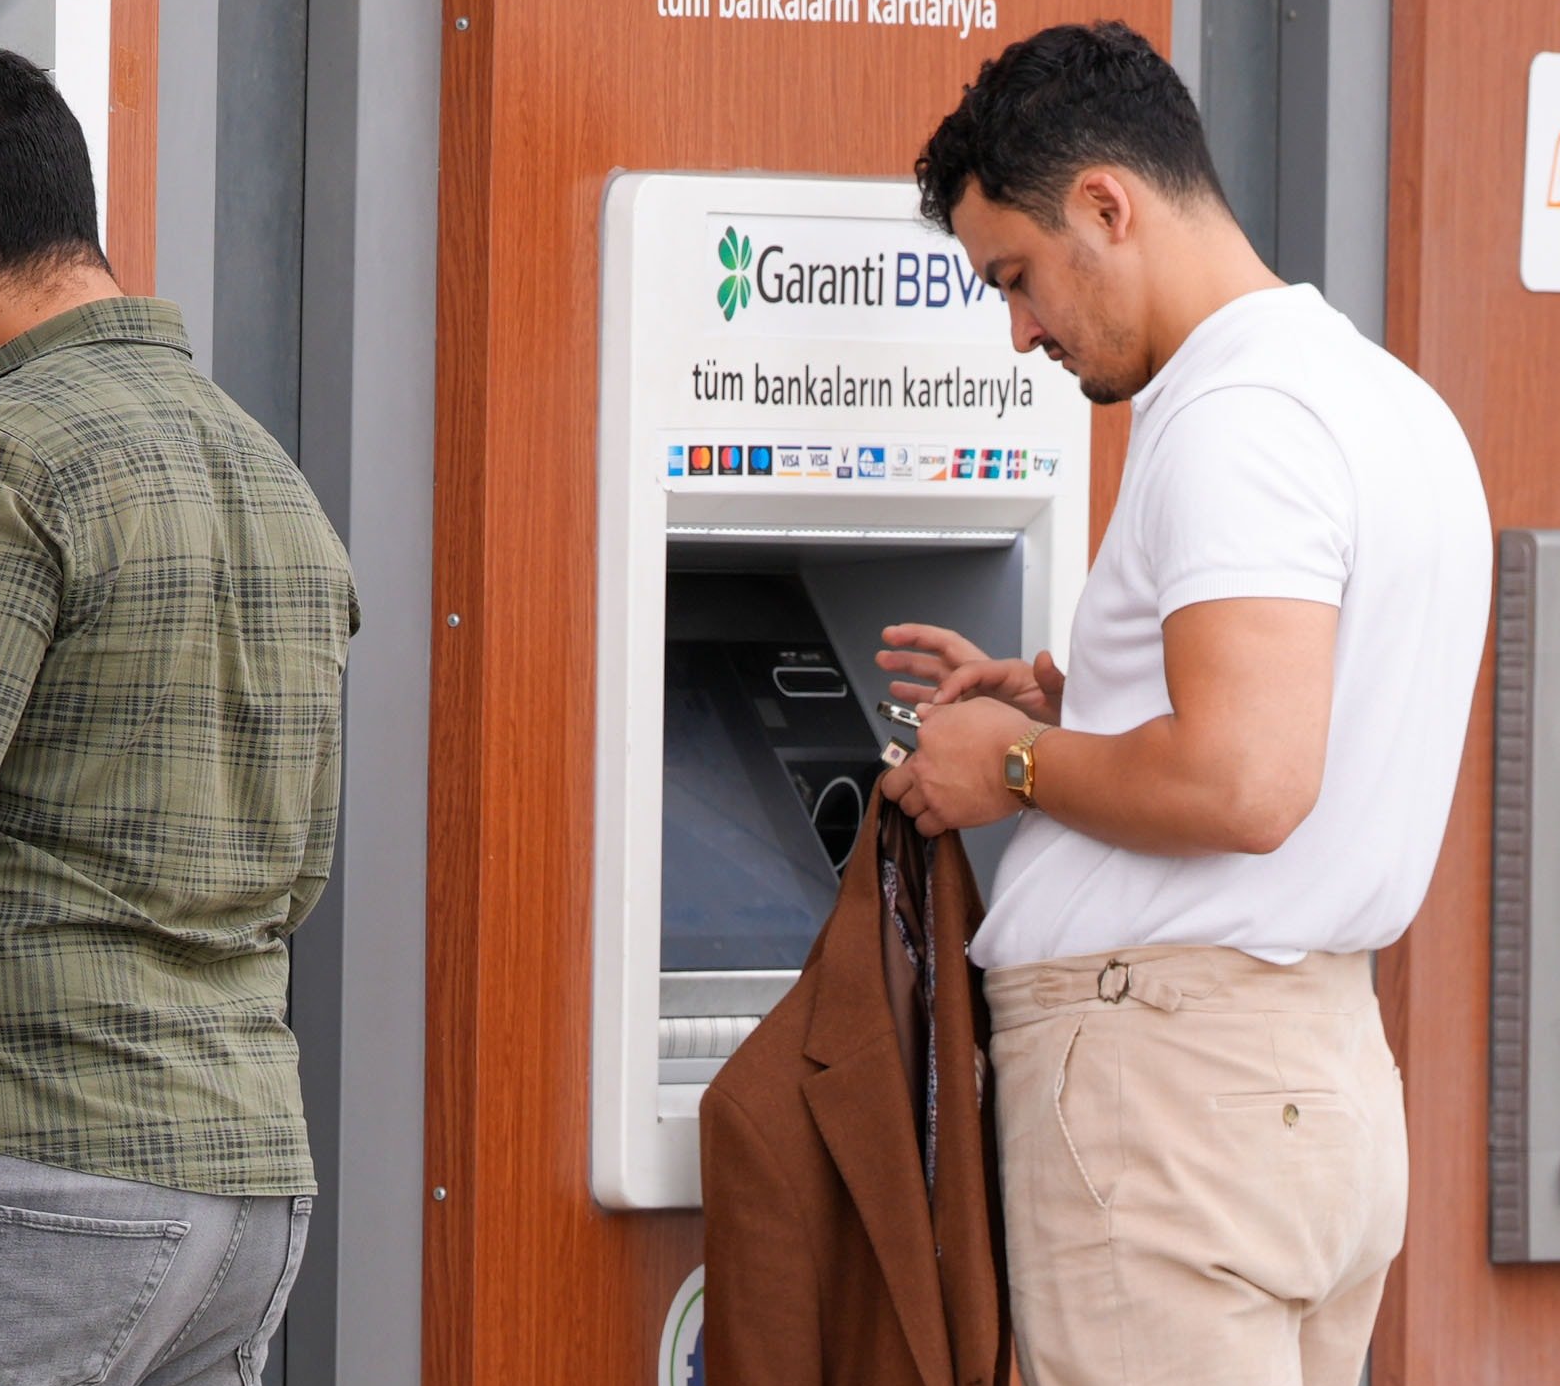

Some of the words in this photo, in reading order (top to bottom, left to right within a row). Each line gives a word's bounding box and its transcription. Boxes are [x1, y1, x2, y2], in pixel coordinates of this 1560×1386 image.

[756, 245, 885, 306] Garanti
[692, 360, 744, 403] tüm
[754, 363, 892, 407] bankaların
[904, 366, 1034, 418] kartlarıyla
[780, 454, 799, 468] VISA
[809, 453, 828, 466] VISA
[1033, 455, 1058, 476] troy
